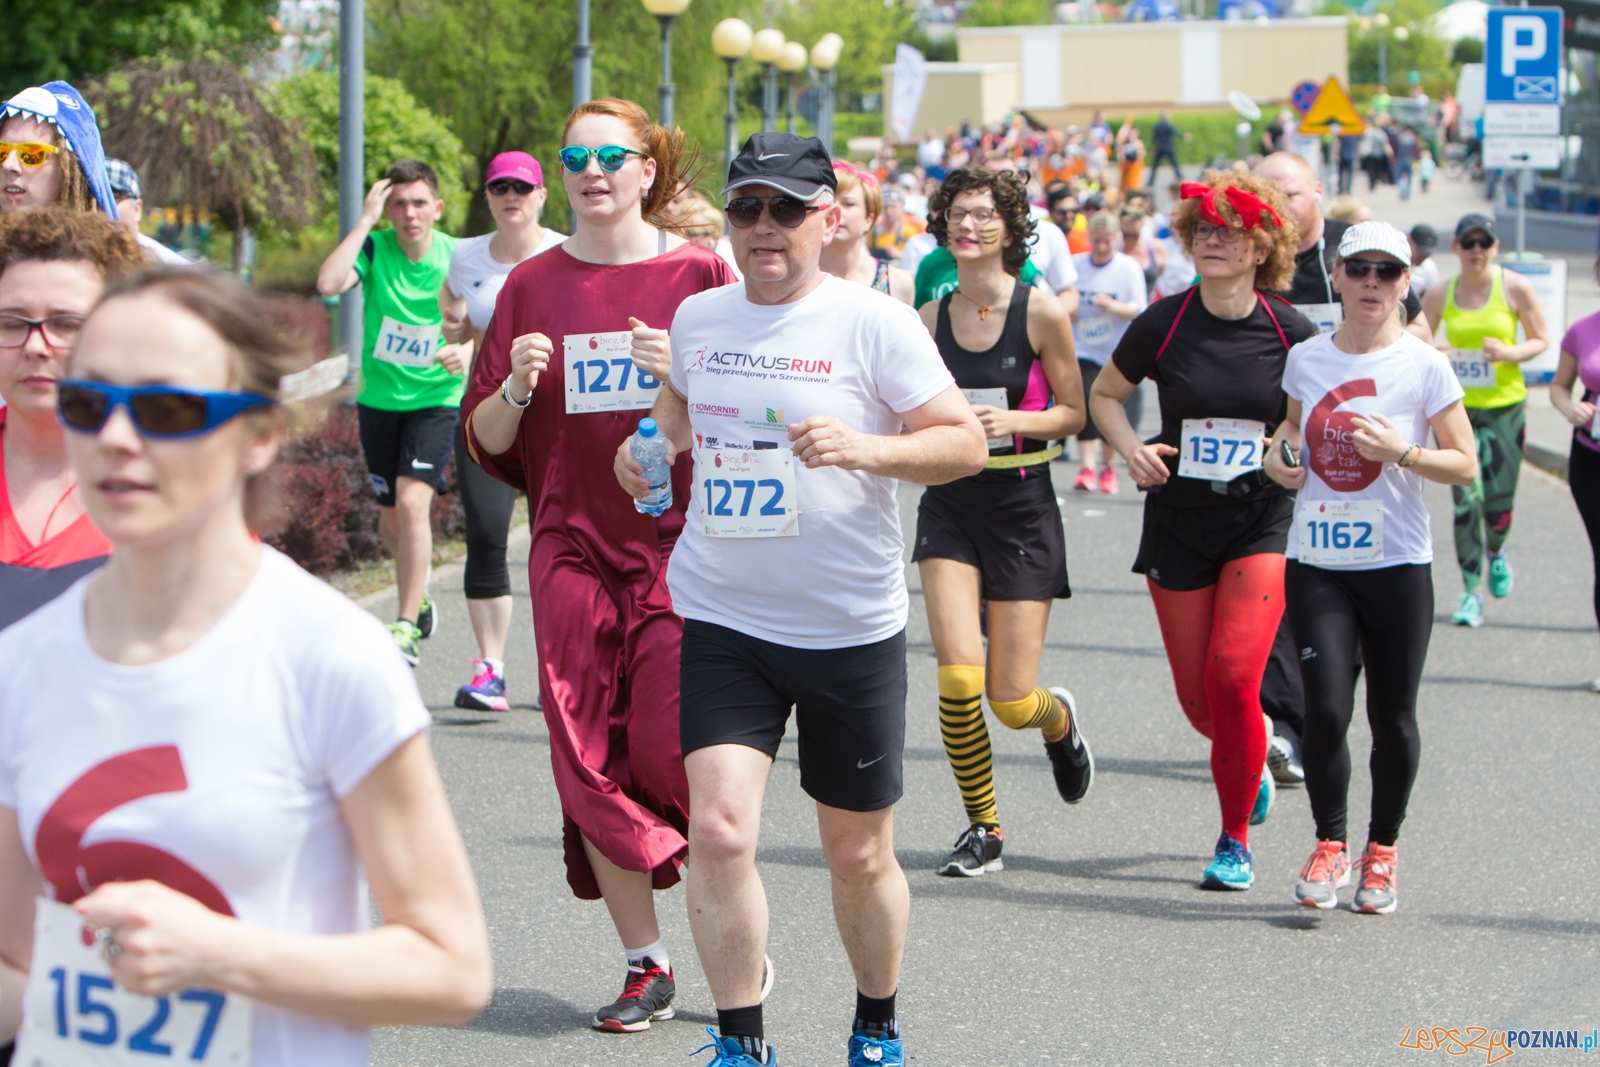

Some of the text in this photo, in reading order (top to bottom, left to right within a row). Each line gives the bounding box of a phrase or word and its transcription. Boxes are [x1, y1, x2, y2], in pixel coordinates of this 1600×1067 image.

[1501, 15, 1547, 77] P
[386, 333, 430, 357] 1741
[706, 366, 721, 375] bieg
[722, 369, 767, 379] przełajowy
[779, 373, 830, 383] Szreniawie
[707, 351, 832, 374] ACTIVUSRUN
[573, 358, 660, 393] 1278
[695, 403, 739, 415] KOMORNIKI
[1323, 418, 1354, 443] bie
[723, 452, 741, 467] bieg
[1189, 436, 1256, 466] 1372
[1338, 454, 1363, 467] tak
[1345, 470, 1362, 478] Spirit
[704, 478, 786, 516] 1272
[1307, 520, 1373, 549] 1162
[50, 967, 227, 1061] 1527
